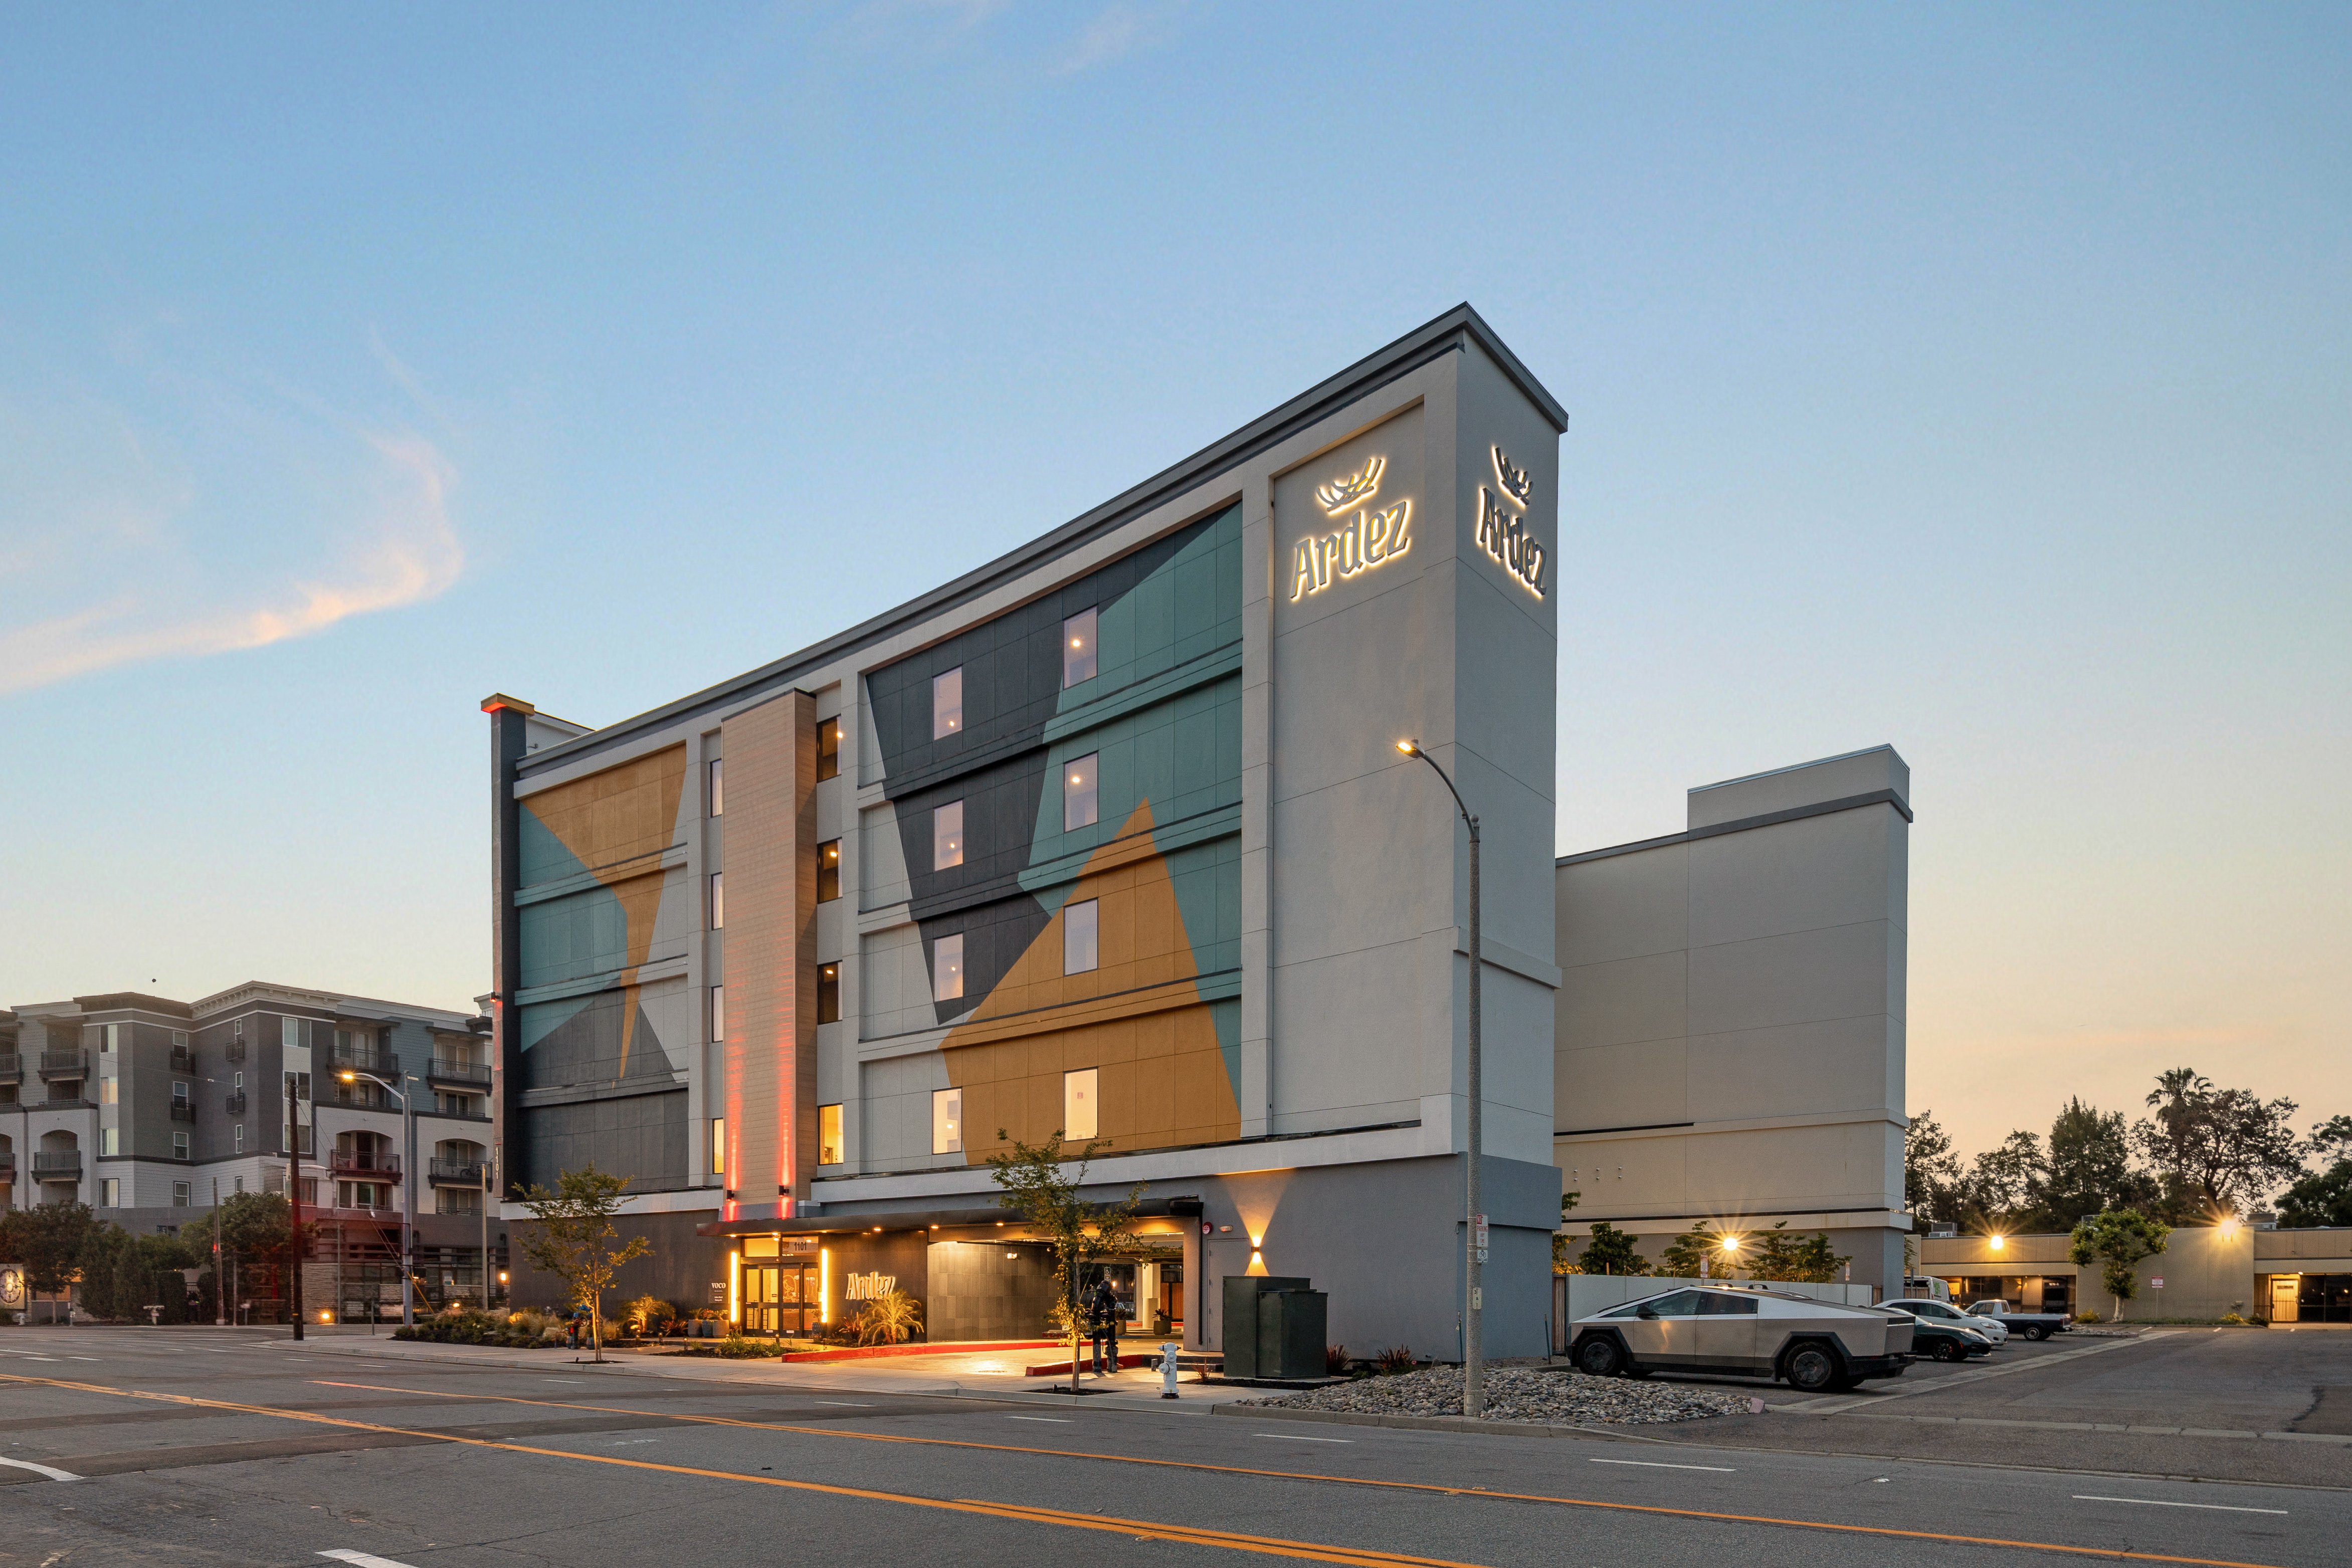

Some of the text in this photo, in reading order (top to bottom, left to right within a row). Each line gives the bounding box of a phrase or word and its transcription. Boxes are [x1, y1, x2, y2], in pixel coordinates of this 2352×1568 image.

[1290, 501, 1408, 600] Ardez
[1479, 488, 1547, 596] Ardez
[794, 1242, 807, 1251] 1101
[845, 1271, 895, 1300] Ardez
